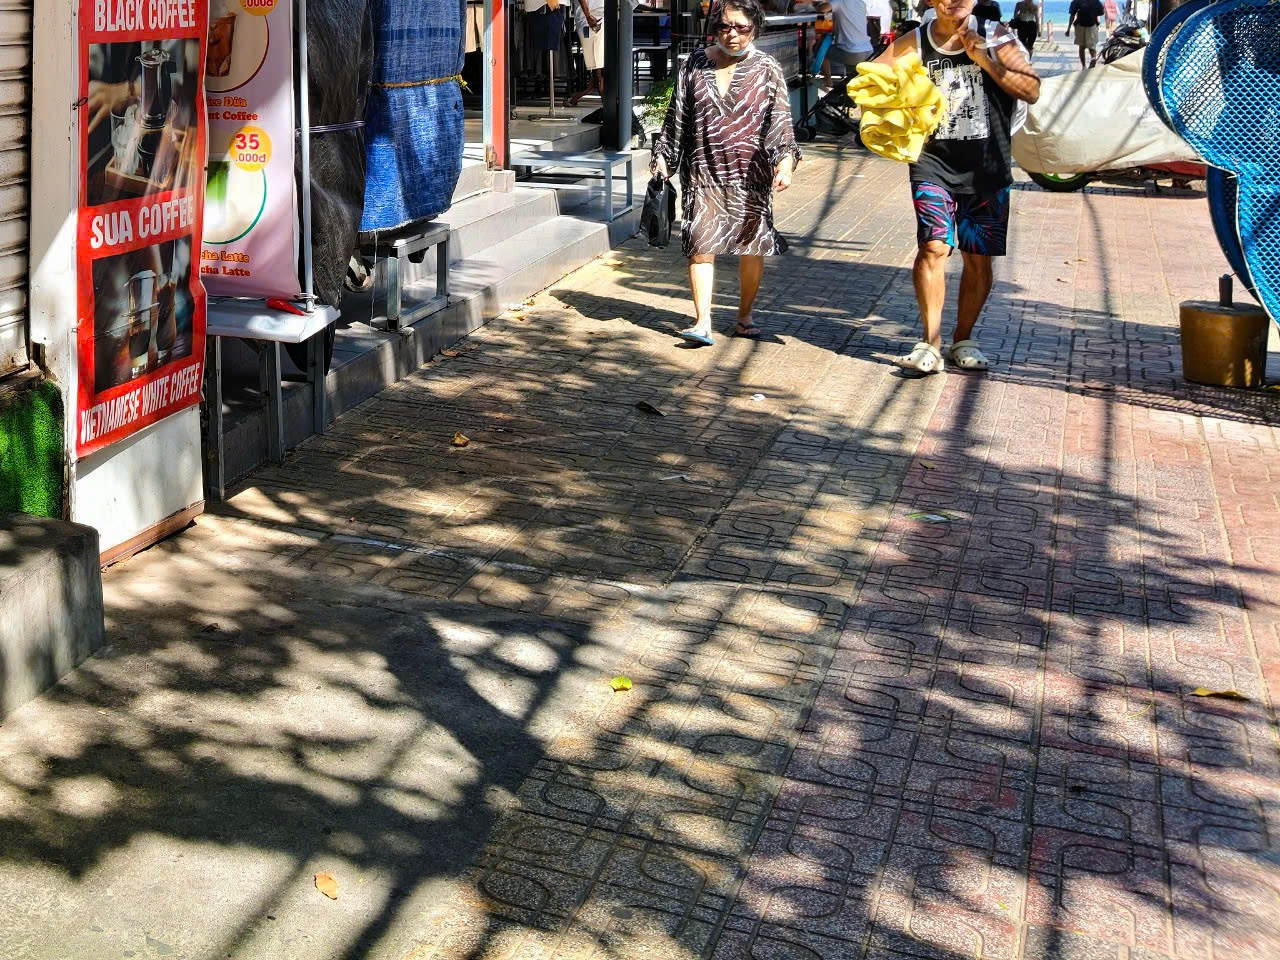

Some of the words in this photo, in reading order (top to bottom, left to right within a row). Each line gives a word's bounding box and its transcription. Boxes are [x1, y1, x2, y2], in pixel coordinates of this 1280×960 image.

[222, 111, 258, 121] Coffee
[235, 133, 260, 150] 35
[90, 210, 133, 249] SUA
[138, 195, 194, 239] COFFEE
[221, 250, 250, 263] Latte
[222, 266, 250, 276] Latte
[80, 387, 141, 445] VIETNAMESE
[141, 375, 170, 417] WHITE
[169, 362, 200, 404] COFFEE
